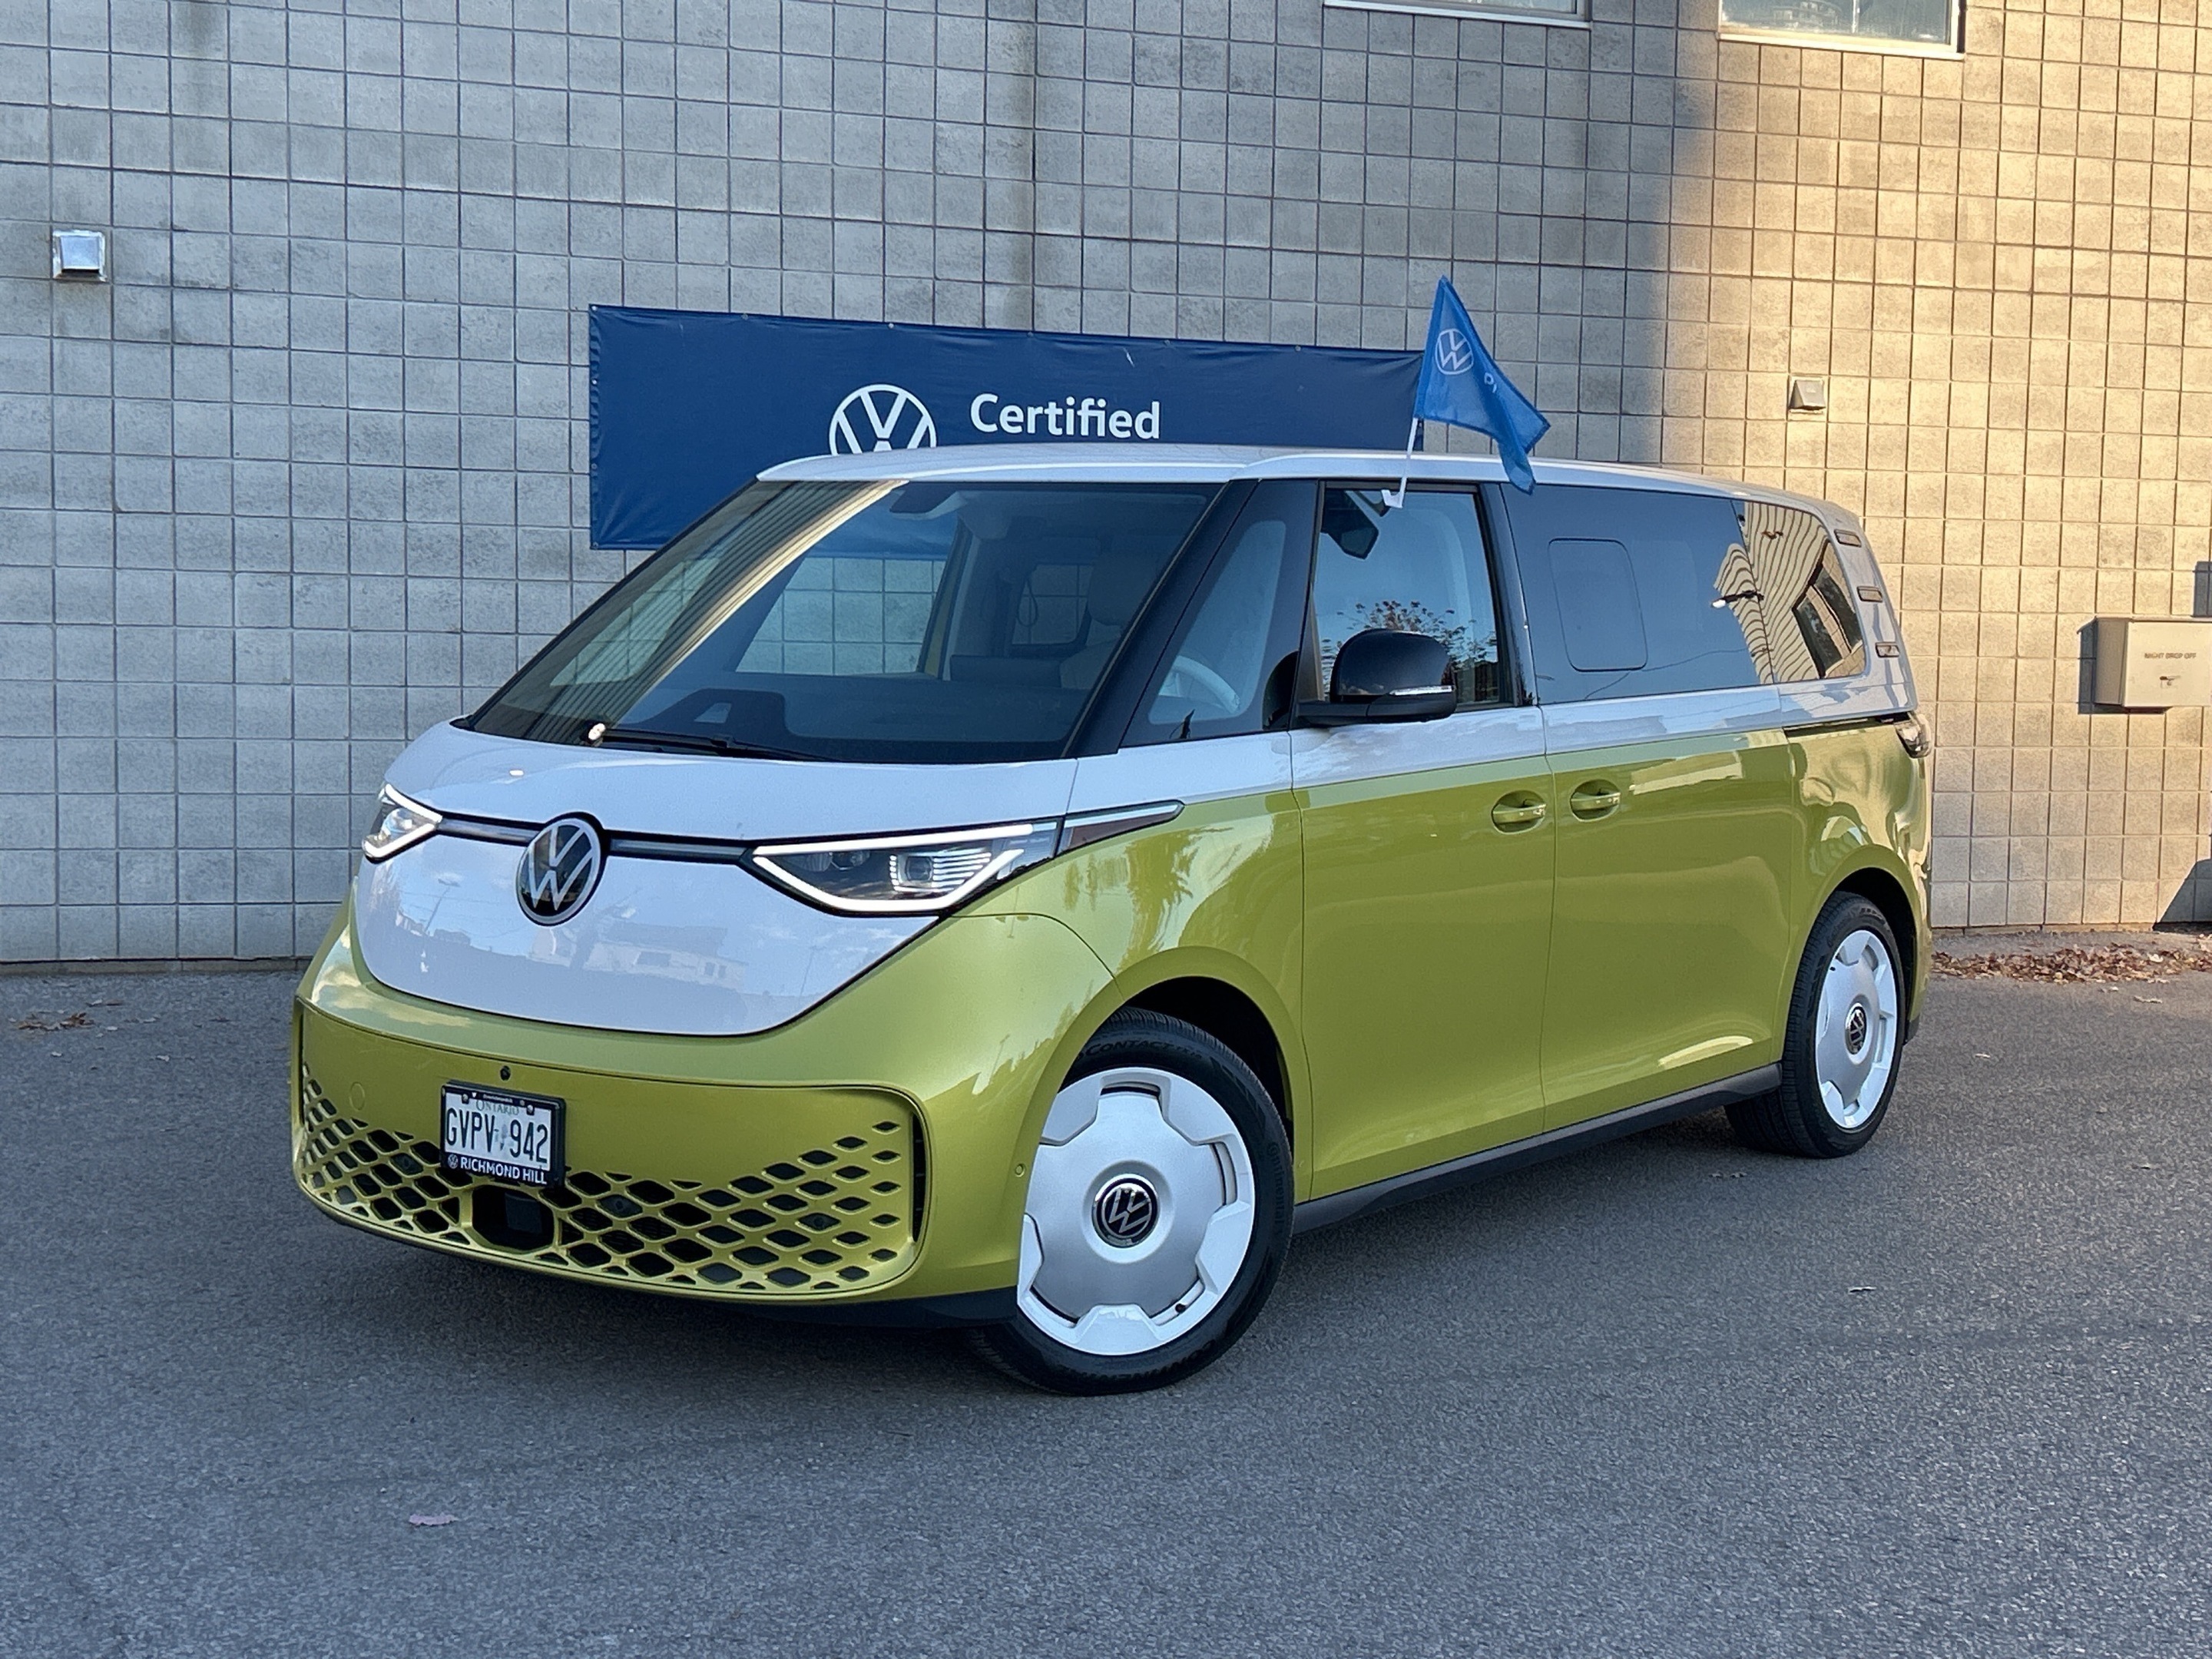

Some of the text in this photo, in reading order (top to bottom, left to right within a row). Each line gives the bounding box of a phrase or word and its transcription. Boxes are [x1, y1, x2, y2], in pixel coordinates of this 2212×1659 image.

[970, 392, 1161, 439] Certified
[521, 820, 598, 920] VW
[461, 1157, 520, 1179] RICHMOND
[522, 1171, 547, 1184] HILL
[1104, 1184, 1153, 1236] VW
